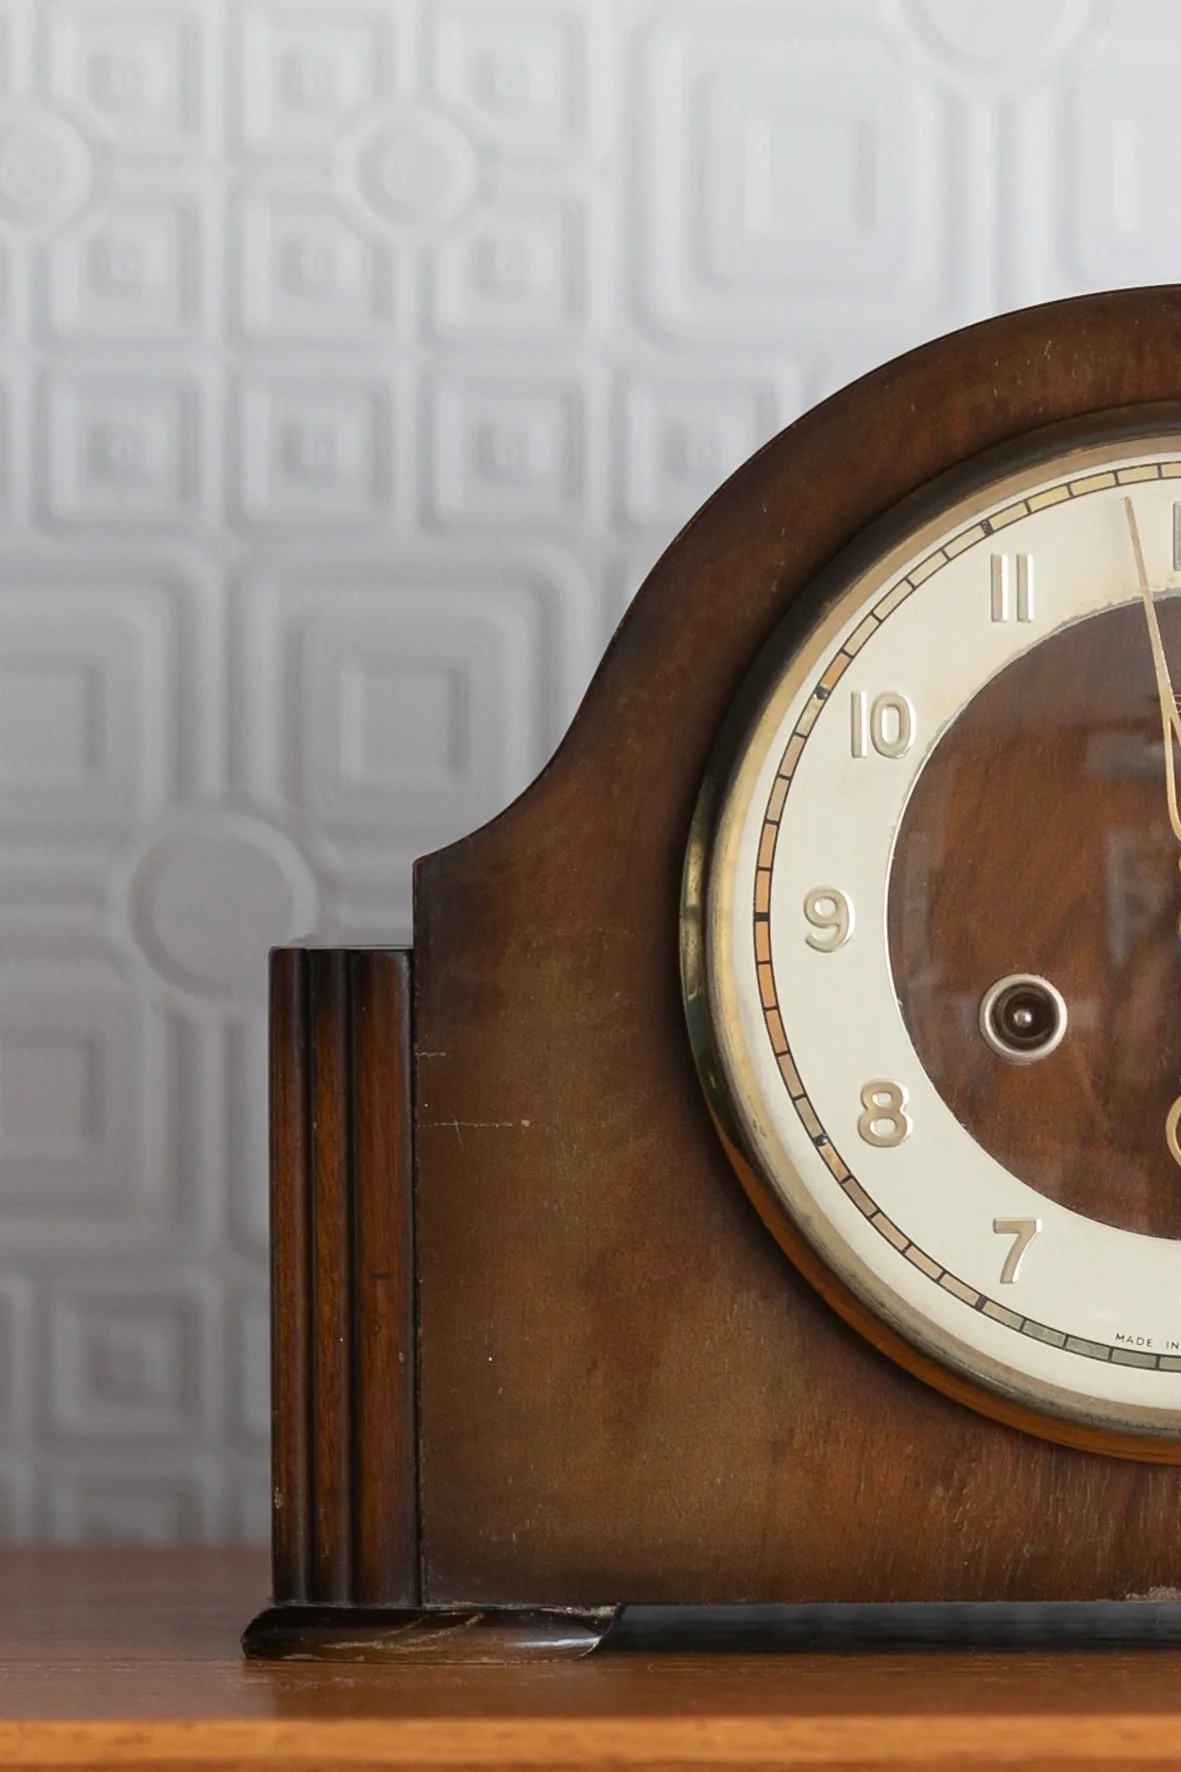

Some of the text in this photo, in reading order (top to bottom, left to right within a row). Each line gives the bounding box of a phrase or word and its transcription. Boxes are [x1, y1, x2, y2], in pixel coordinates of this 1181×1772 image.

[991, 552, 1034, 624] 11
[850, 689, 917, 760] 10
[803, 885, 857, 954] 9
[857, 1078, 914, 1148] 8
[992, 1217, 1043, 1285] 7
[1115, 1333, 1153, 1348] MADE
[1166, 1341, 1180, 1350] IN
